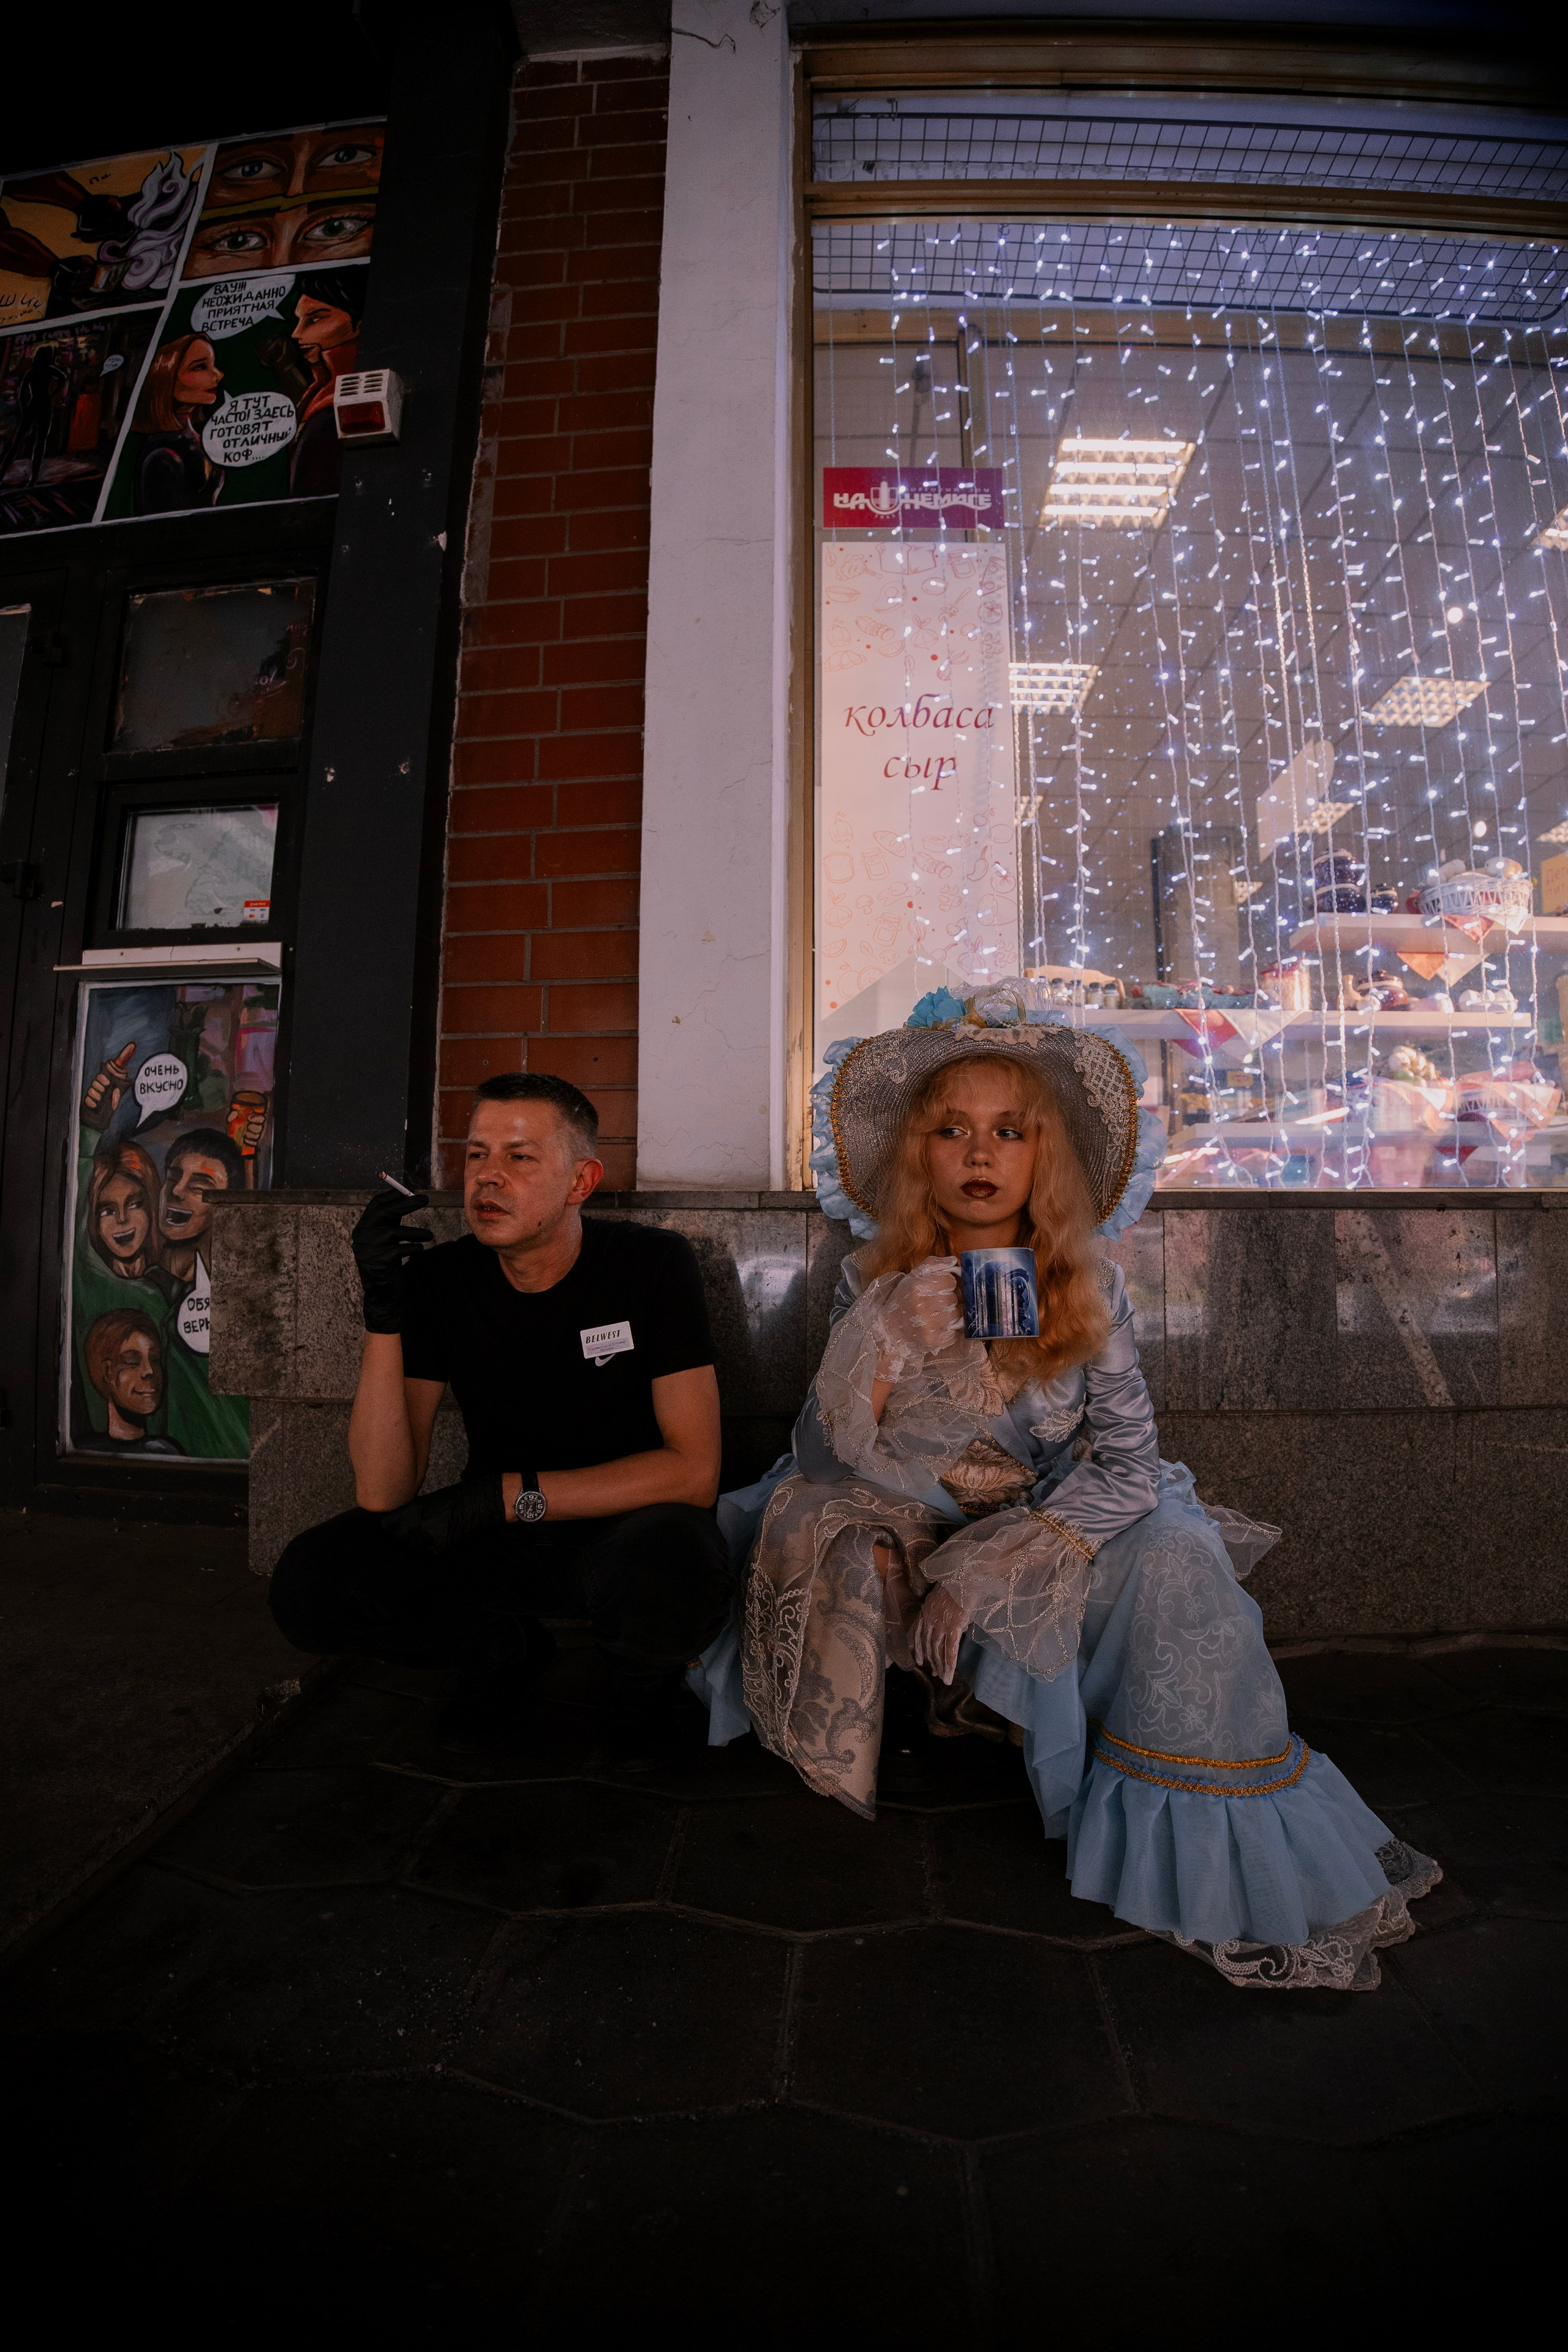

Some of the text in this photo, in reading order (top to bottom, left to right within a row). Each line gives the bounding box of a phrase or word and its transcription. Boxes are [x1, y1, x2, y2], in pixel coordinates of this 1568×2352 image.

[202, 286, 286, 308] НЕОЖИДАННО
[214, 281, 247, 295] ВАУ!!!
[207, 300, 274, 319] ПРИЯТНАЯ
[201, 316, 254, 333] ВСТРЕЧА
[227, 395, 271, 412] Я ТУТ
[211, 404, 295, 426] ЧАСТО! ЗДЕСЬ
[209, 420, 273, 440] ГОТОВЯТ
[844, 693, 996, 737] колбаса
[883, 756, 957, 791] сыр
[144, 1064, 179, 1077] ОЧЕНЬ
[139, 1078, 184, 1095] ВКУСНО
[586, 1329, 621, 1344] BELWEST
